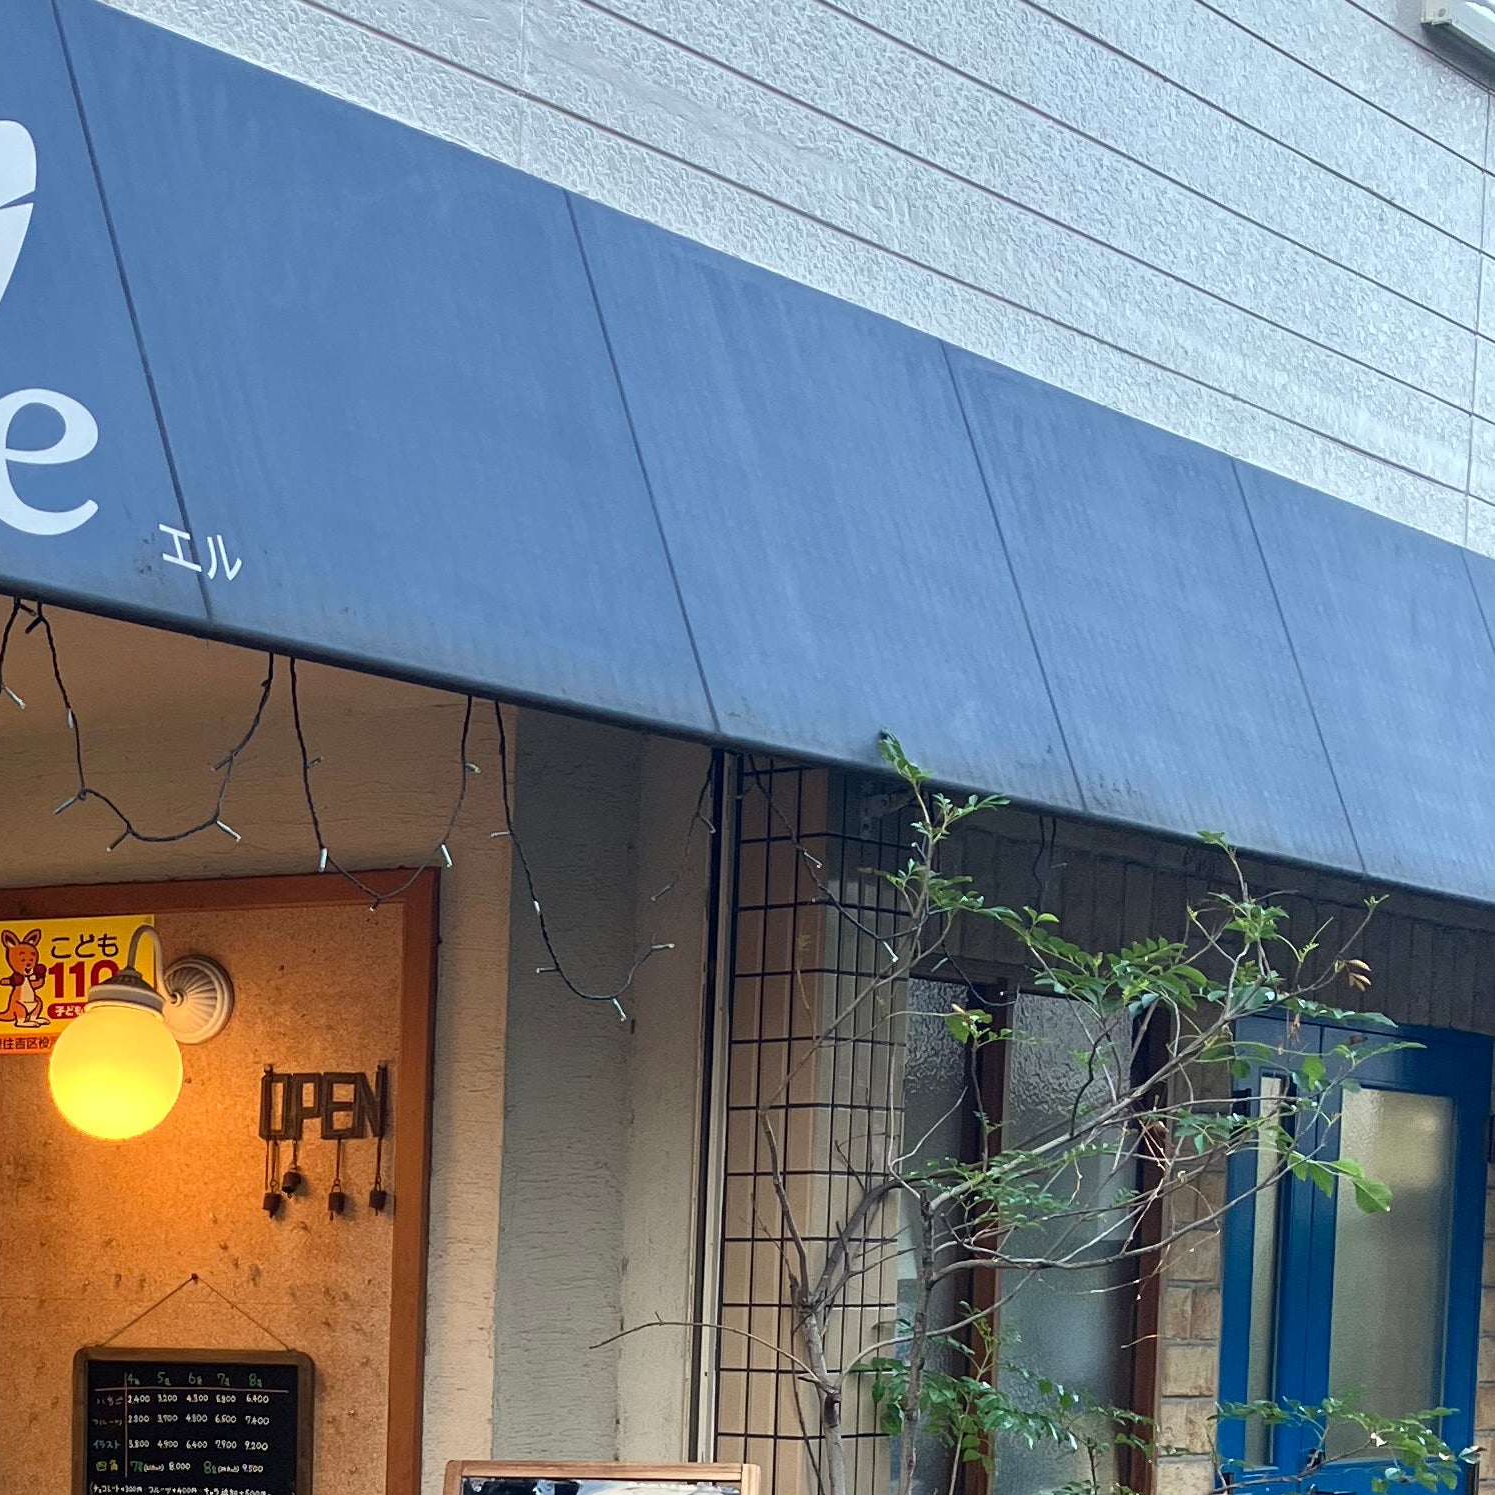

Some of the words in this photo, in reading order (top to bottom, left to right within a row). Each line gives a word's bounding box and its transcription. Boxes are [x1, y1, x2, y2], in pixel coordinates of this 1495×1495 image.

[158, 523, 242, 581] エル
[51, 933, 119, 959] こども
[259, 1071, 388, 1140] OPEN
